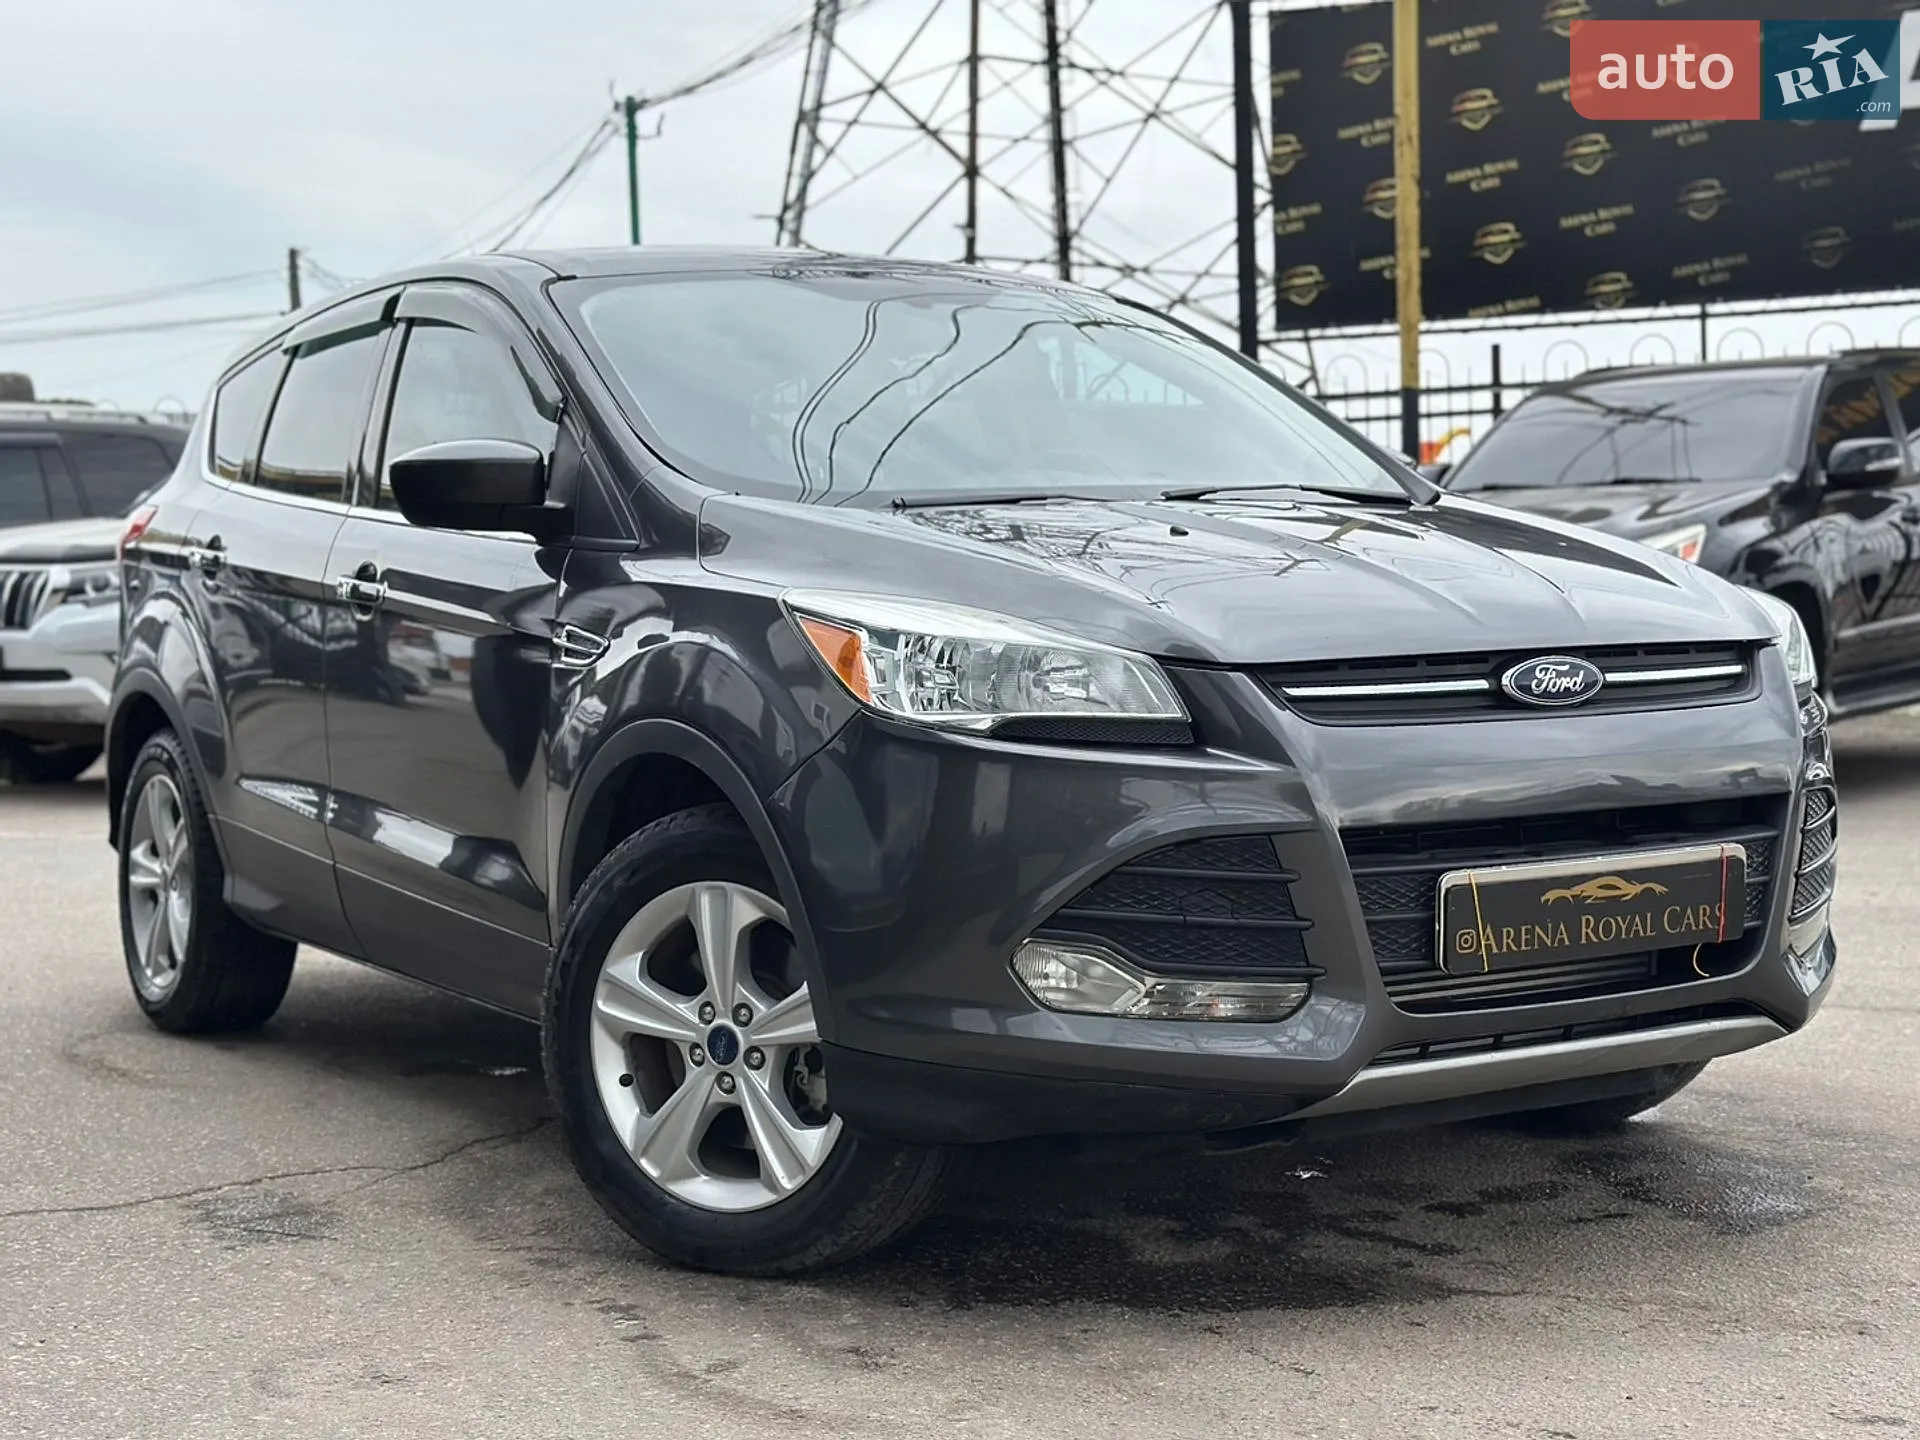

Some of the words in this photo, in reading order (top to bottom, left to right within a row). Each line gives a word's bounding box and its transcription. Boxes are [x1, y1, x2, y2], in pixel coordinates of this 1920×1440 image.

[1531, 664, 1585, 694] Ford
[1478, 922, 1570, 955] ARENA
[1580, 913, 1656, 944] ROYAL
